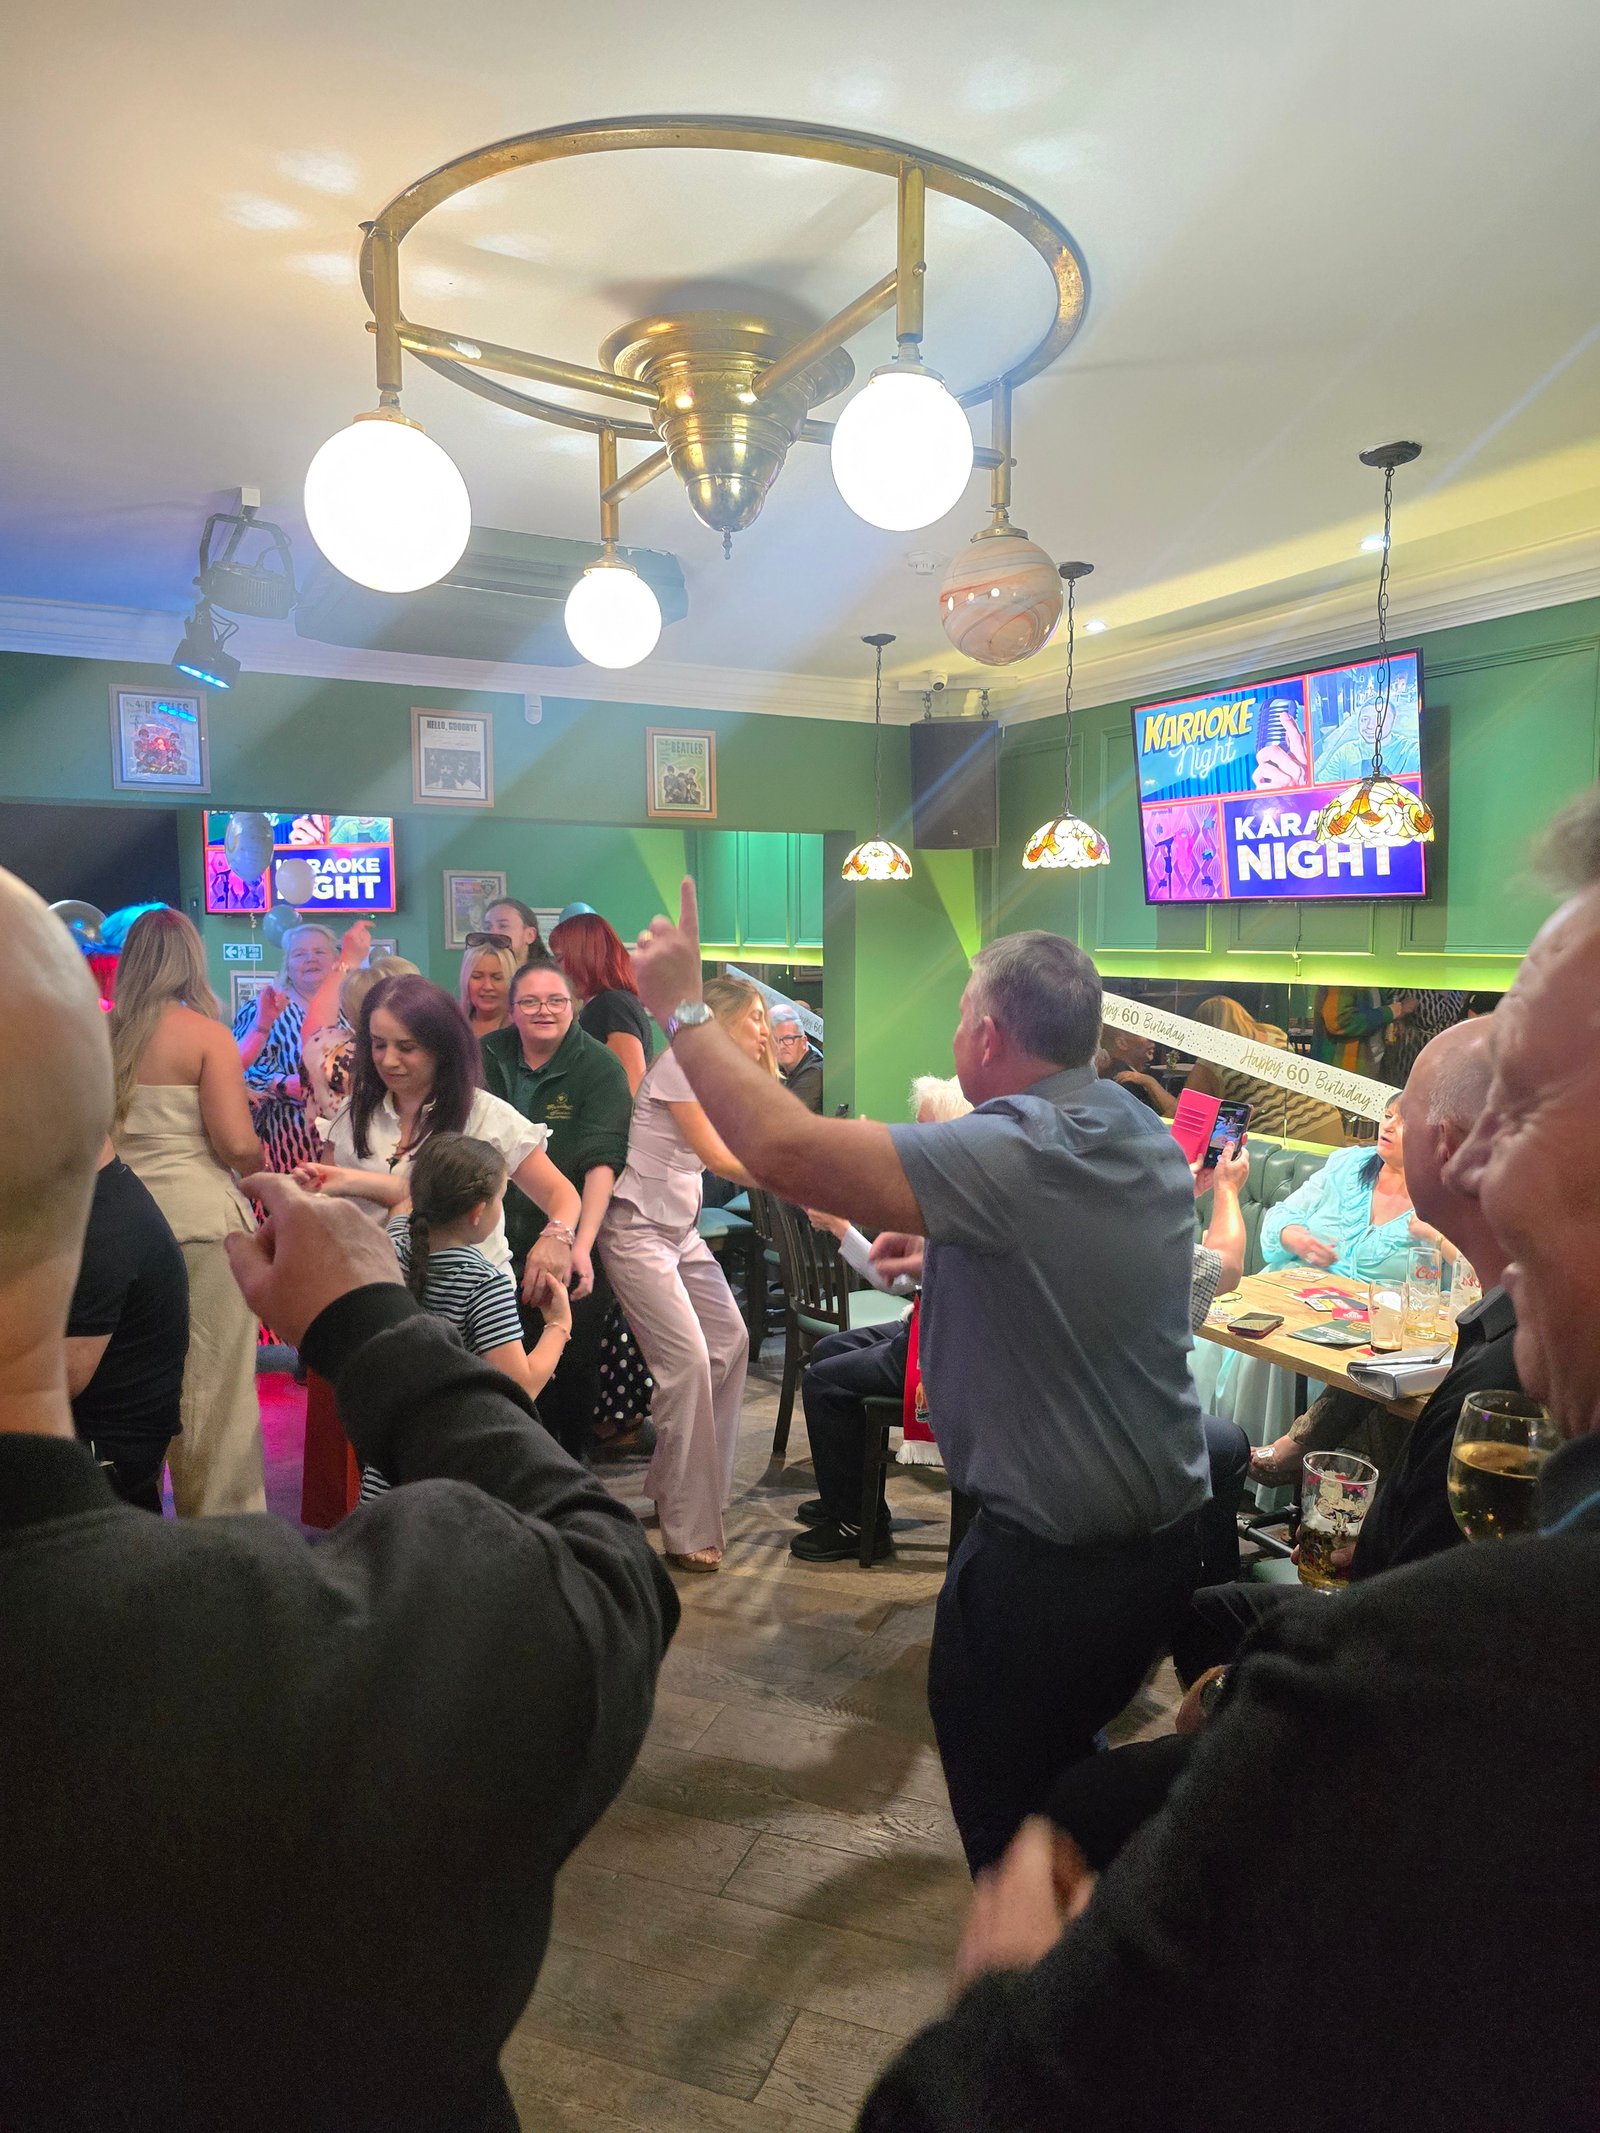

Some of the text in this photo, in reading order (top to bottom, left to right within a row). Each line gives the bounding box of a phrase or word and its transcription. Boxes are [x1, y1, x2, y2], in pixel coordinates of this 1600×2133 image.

[1143, 697, 1256, 754] KARAOKE
[671, 741, 704, 755] BEATLES
[1168, 736, 1236, 779] Night
[1234, 810, 1317, 841] KARA
[1236, 839, 1392, 881] NIGHT
[1121, 1007, 1140, 1025] 60
[1143, 1012, 1185, 1047] Birthday
[1240, 1045, 1372, 1112] Happy 60 Birthday
